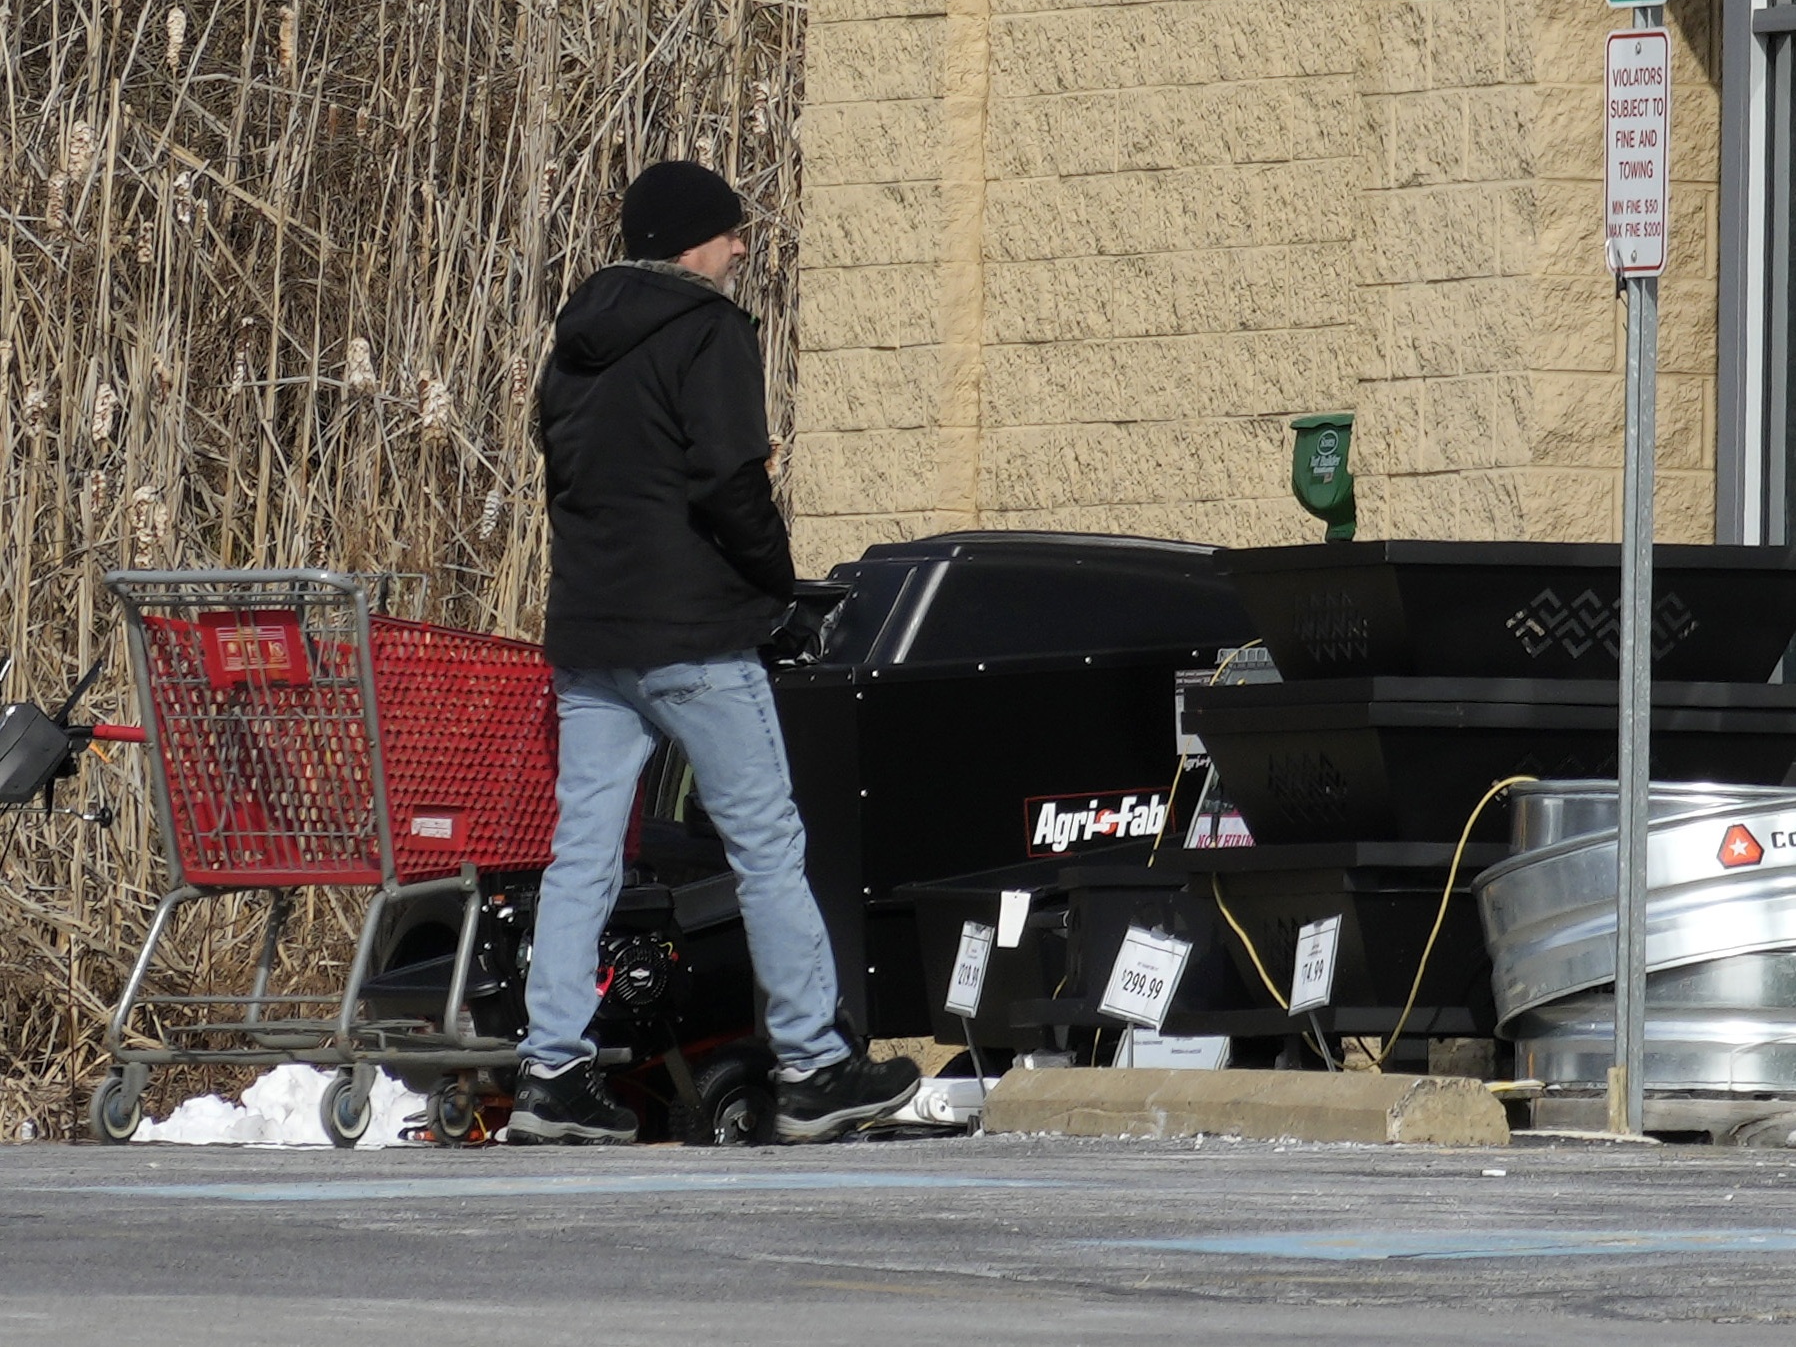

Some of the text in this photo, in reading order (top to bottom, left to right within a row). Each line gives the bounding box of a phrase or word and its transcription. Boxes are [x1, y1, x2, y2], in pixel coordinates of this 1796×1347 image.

[1612, 67, 1663, 87] VIOLATORS
[1610, 98, 1664, 118] SUBJECT TO
[1615, 129, 1657, 149] FINE AND
[1618, 160, 1653, 181] TOWING
[1612, 198, 1659, 215] MIN FINE $50
[1625, 223, 1640, 238] FINE
[1643, 221, 1661, 238] $200
[1032, 794, 1168, 852] Agri-Fab
[1121, 968, 1164, 1001] $299.99
